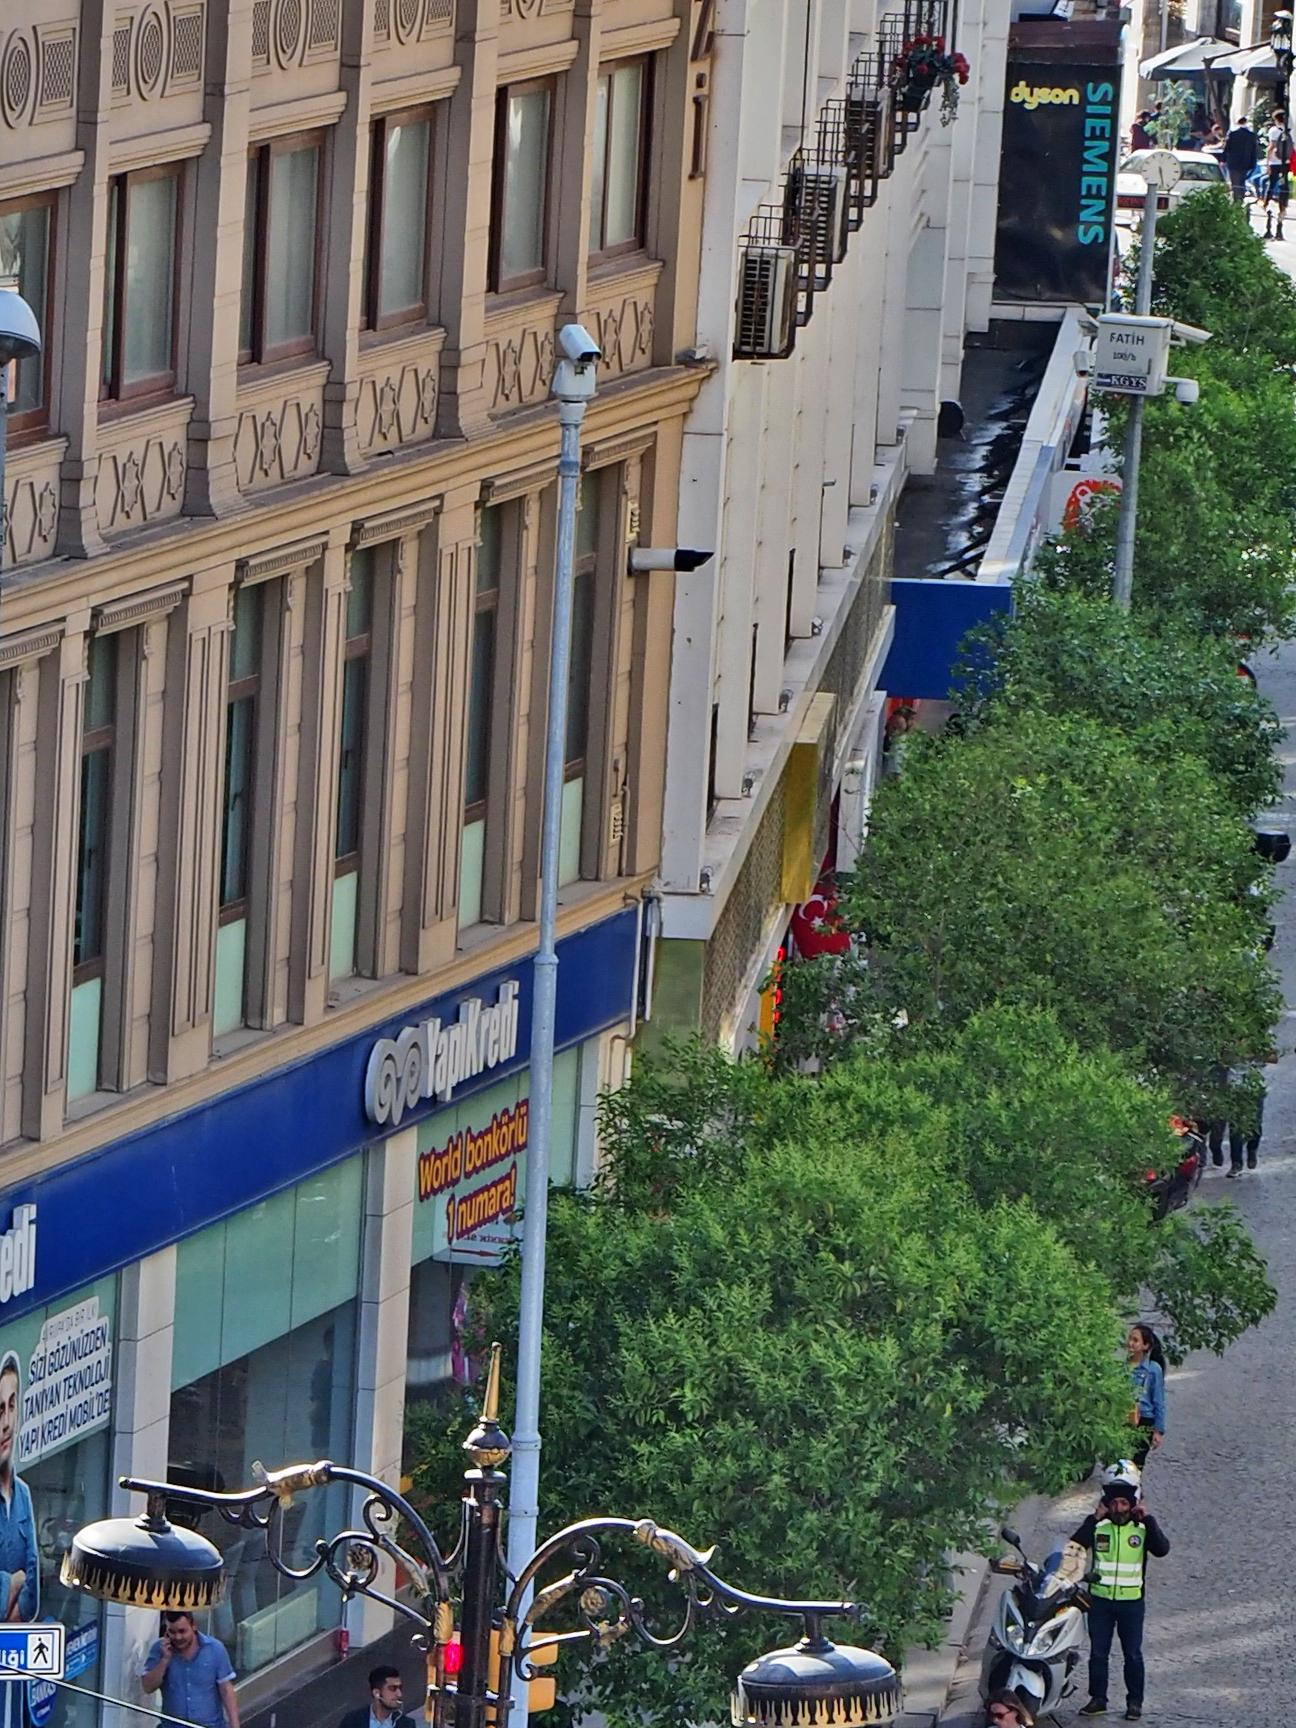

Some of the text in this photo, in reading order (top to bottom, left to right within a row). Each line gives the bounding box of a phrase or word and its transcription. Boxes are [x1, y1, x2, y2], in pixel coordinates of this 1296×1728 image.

[1010, 80, 1080, 110] dyson
[1077, 82, 1114, 245] SIEMENS
[1109, 331, 1145, 346] FATİH
[1111, 375, 1147, 388] KGYS
[421, 981, 520, 1101] YapıKredi
[419, 1103, 529, 1197] World bonkörlü
[447, 1165, 517, 1240] 1 numara!
[48, 1322, 108, 1378] GÖZÜNÜZDEN
[24, 1381, 61, 1422] TANIYAN
[19, 1427, 40, 1458] YAPI
[40, 1404, 68, 1449] KREDİ
